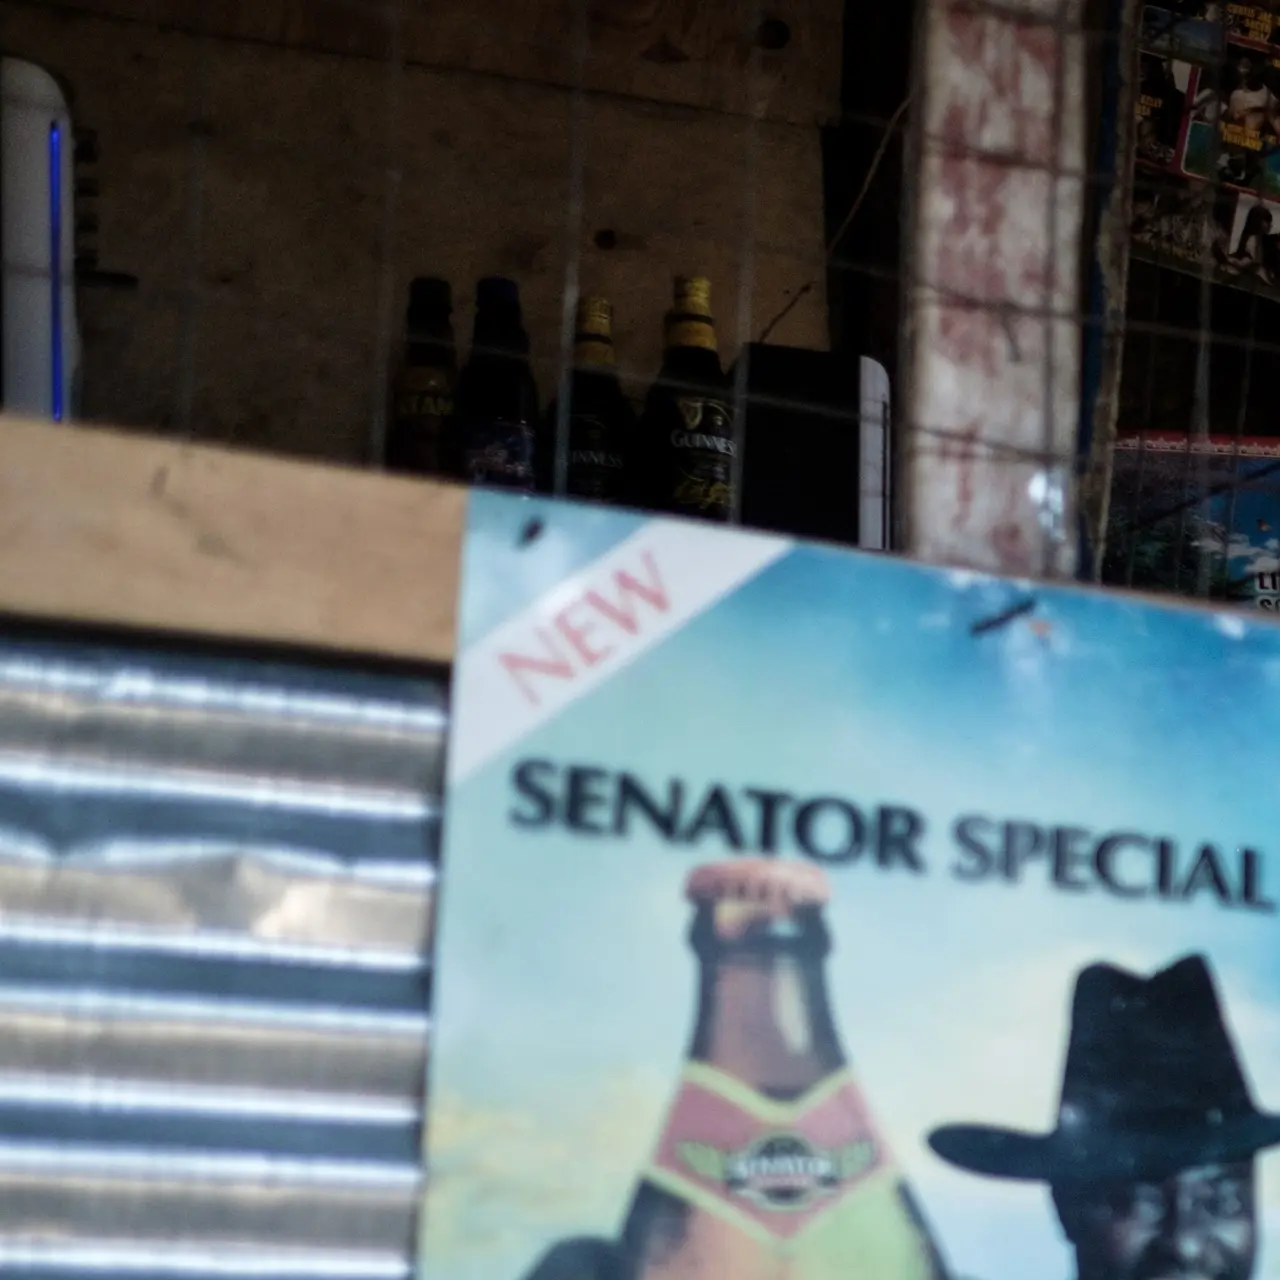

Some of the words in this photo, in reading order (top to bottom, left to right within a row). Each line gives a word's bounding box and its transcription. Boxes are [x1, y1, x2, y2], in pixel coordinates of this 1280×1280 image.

[669, 428, 736, 457] GUINNES
[498, 551, 675, 705] NEW
[509, 759, 926, 874] SENATOR
[952, 814, 1278, 914] SPECIAL
